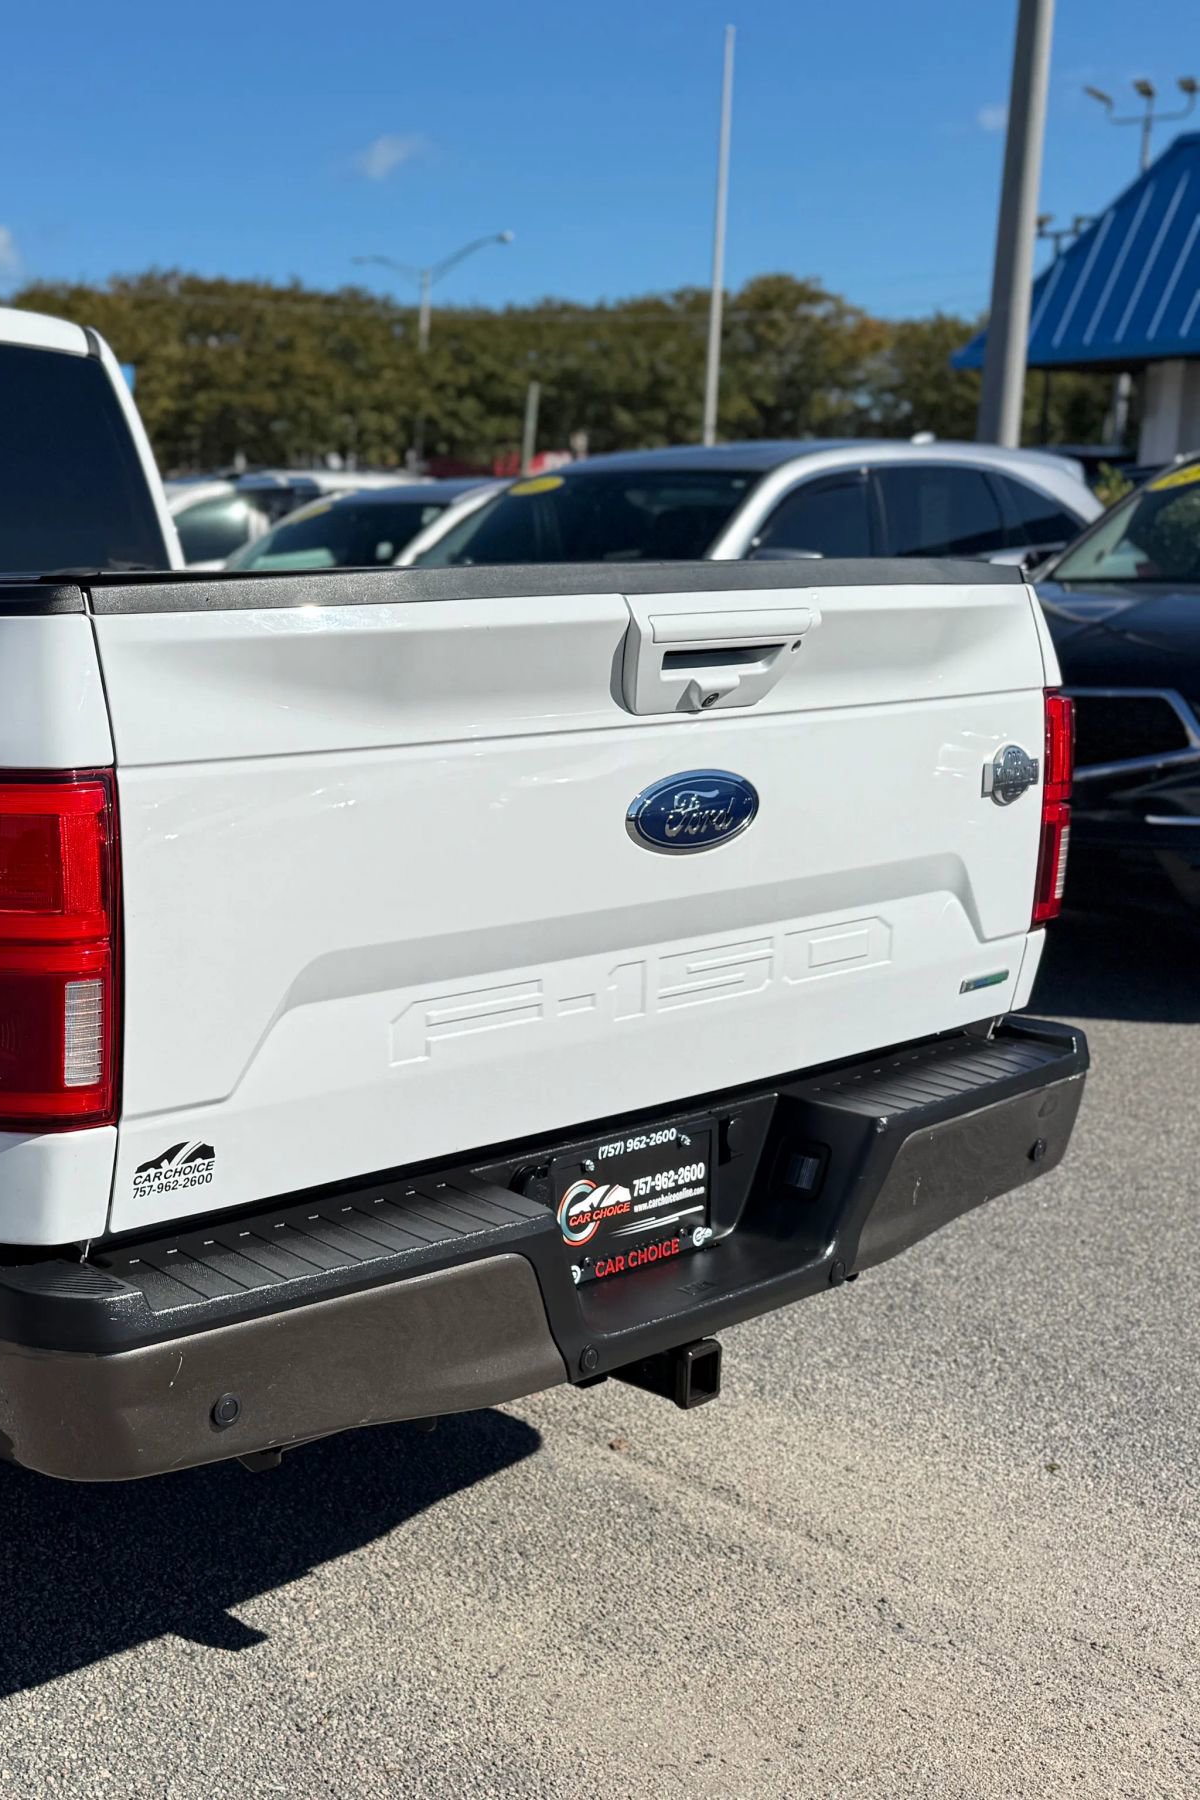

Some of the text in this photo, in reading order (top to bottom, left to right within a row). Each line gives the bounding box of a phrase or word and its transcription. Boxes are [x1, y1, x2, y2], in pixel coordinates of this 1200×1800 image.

[664, 789, 735, 838] Ford
[388, 915, 893, 1068] F-150
[598, 1128, 677, 1160] (757) 962-2600
[133, 1161, 215, 1187] CAR CHOICE
[133, 1173, 212, 1199] 757-962-2600
[633, 1162, 705, 1197] 757-962-2600
[568, 1202, 632, 1227] CAR CHOICE
[595, 1237, 681, 1278] CAR CHOICE
